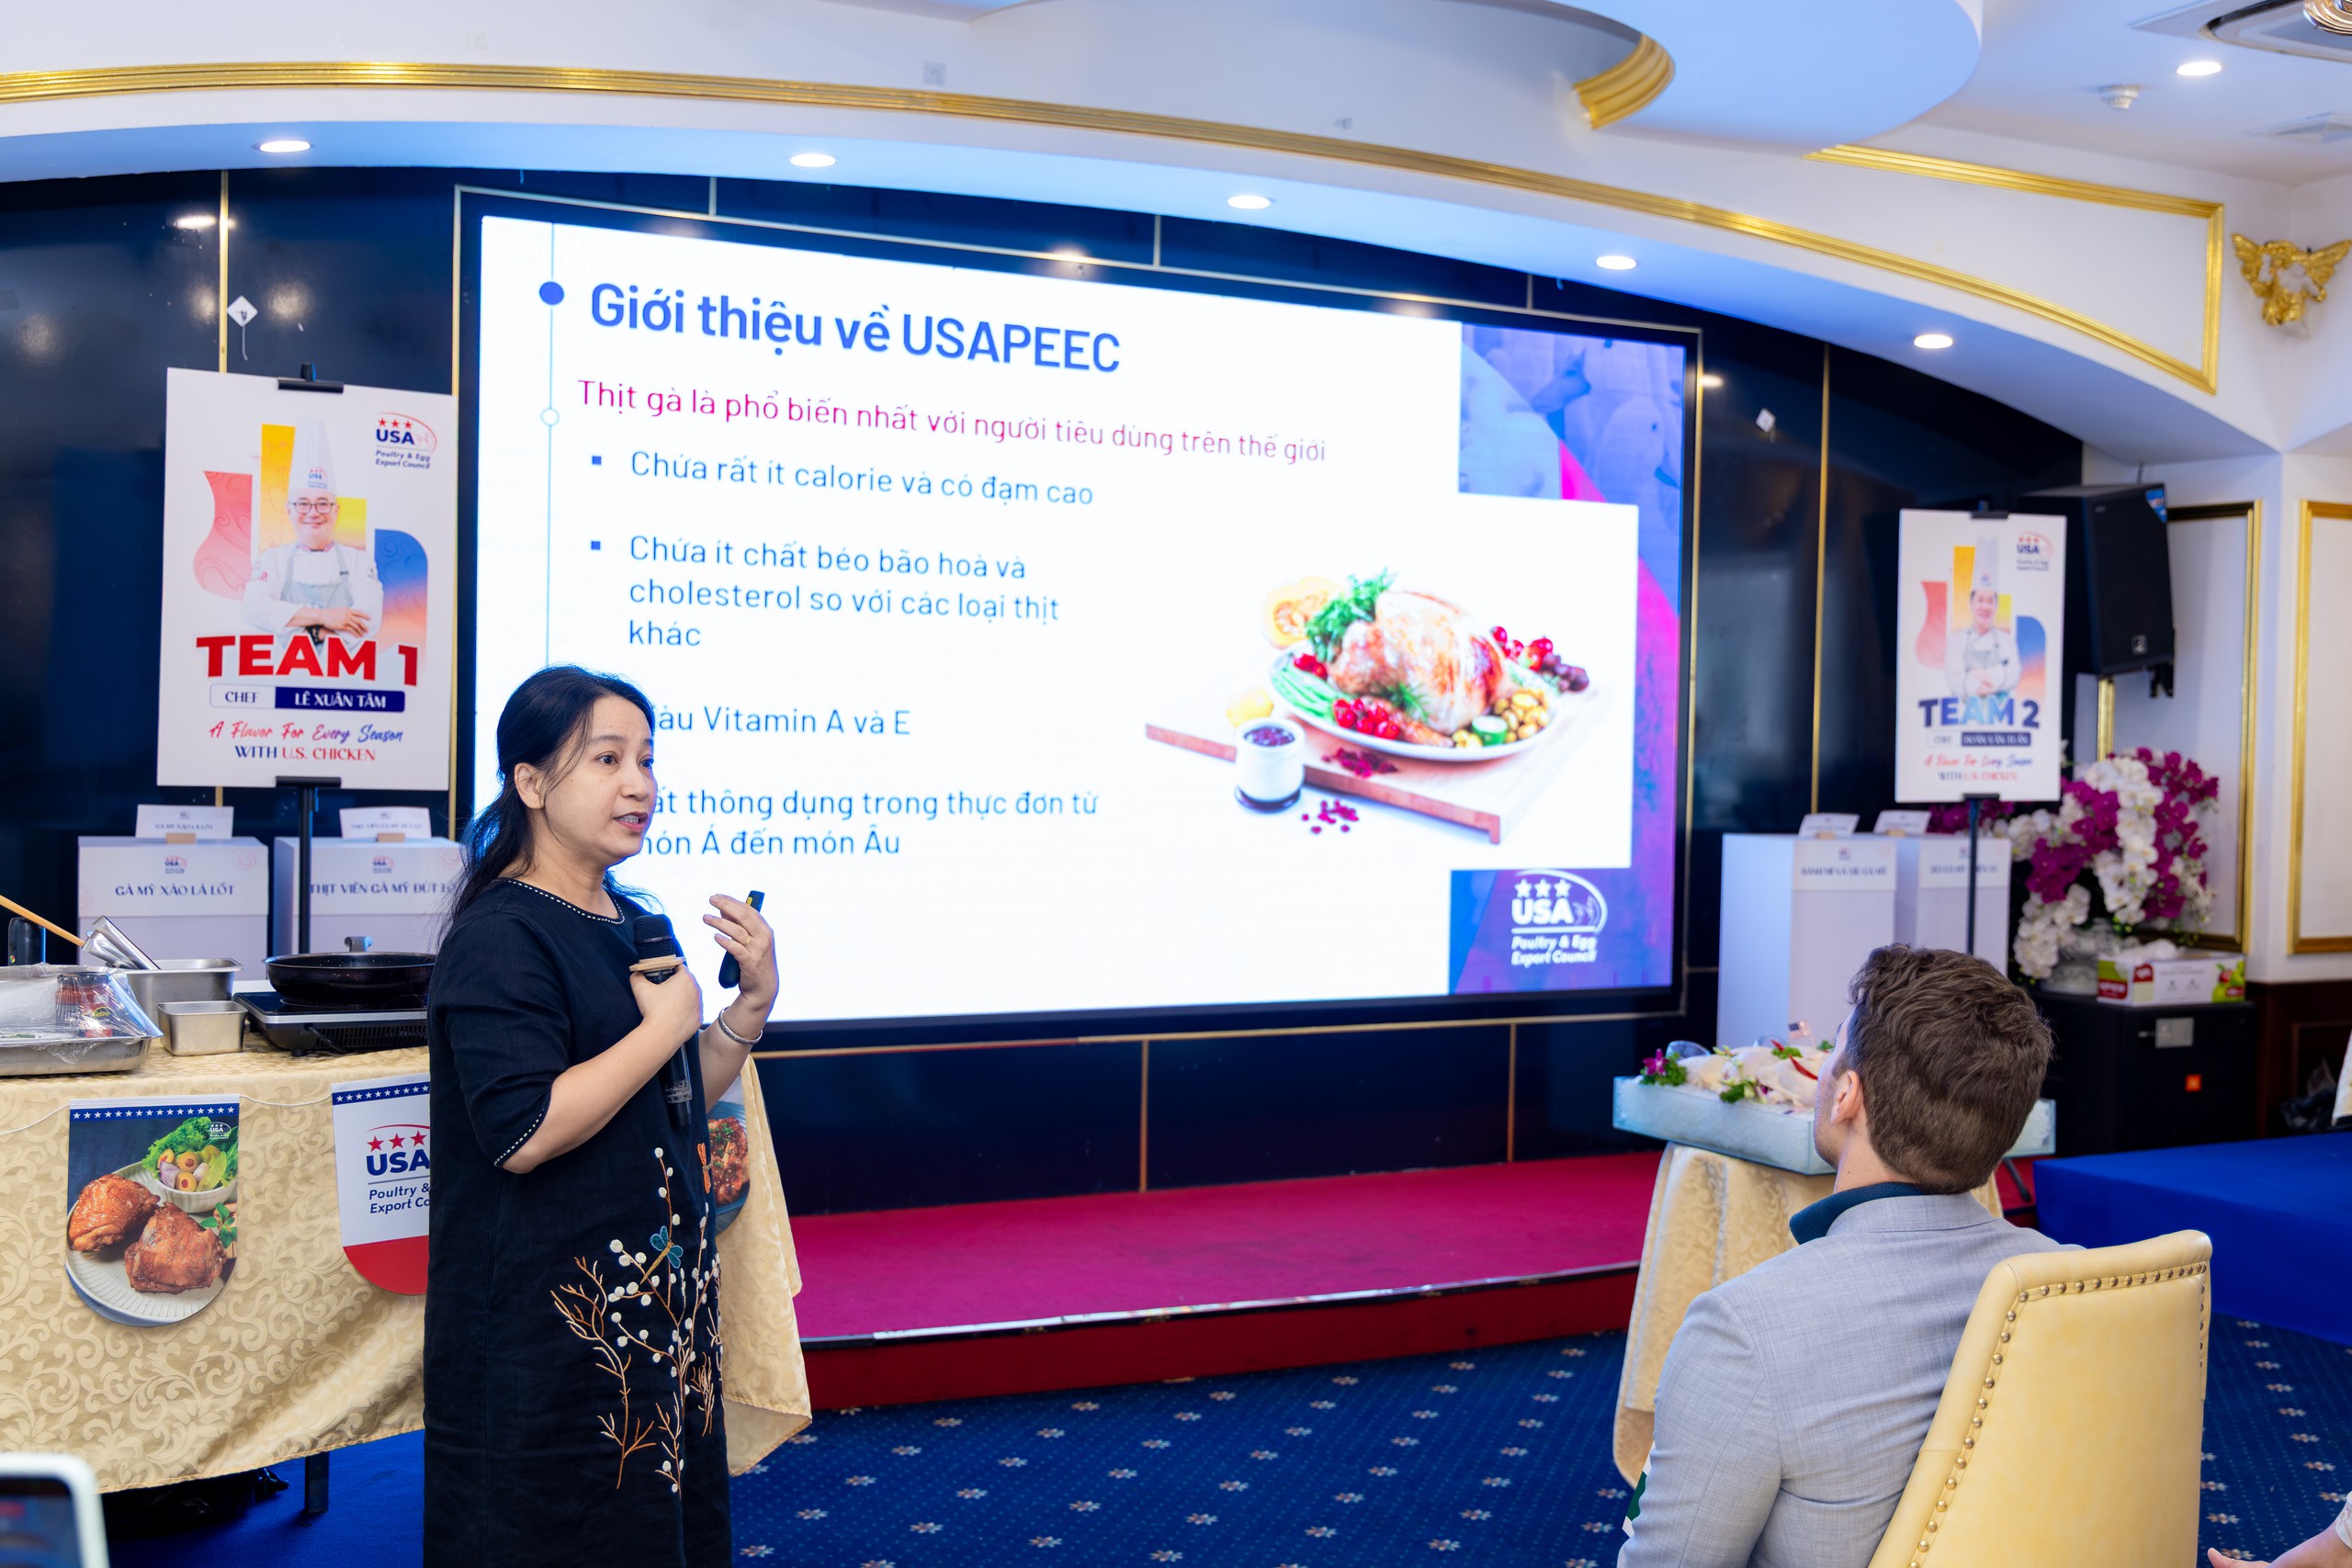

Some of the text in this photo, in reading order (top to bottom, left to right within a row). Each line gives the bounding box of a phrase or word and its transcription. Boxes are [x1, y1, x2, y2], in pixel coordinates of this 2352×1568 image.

[592, 283, 1120, 372] Giới thiệu về USAPEEC
[578, 379, 1325, 465] Thịt gà là phổ biến nhất với người tiêu dùng trên thế giới
[376, 428, 414, 446] USA
[376, 450, 404, 460] Poultry
[416, 453, 431, 462] Egg
[376, 458, 431, 469] Export Council
[631, 450, 1093, 505] Chứa rất ít calorie và có đạm cao
[630, 536, 1025, 579] Chứa ít chất béo bão hoà và
[630, 579, 1058, 625] cholesterol so với các loại thịt
[629, 619, 701, 646] khác
[196, 635, 418, 686] TEAM 1
[225, 691, 259, 704] CHEF
[294, 690, 387, 709] LÊ XUÂN TÂM
[659, 705, 910, 735] àu Vitamin A và E
[1918, 696, 2040, 728] TEAM 2
[209, 720, 403, 744] A Flavor For Every Season
[234, 745, 376, 761] WITH U.S. CHICKEN
[655, 785, 1099, 821] ất thông dụng trong thực đơn từ
[702, 824, 720, 855] Á
[731, 828, 782, 855] đến
[794, 830, 854, 855] món
[865, 823, 899, 854] Âu
[115, 883, 134, 896] GÀ
[370, 881, 389, 895] GÀ
[1511, 897, 1575, 925] USA
[1511, 935, 1557, 952] Poultry
[1572, 934, 1598, 952] Egg
[1511, 949, 1597, 968] Export Council
[367, 1149, 430, 1176] USA
[369, 1183, 430, 1200] Poultry &
[370, 1197, 430, 1214] Export Co
